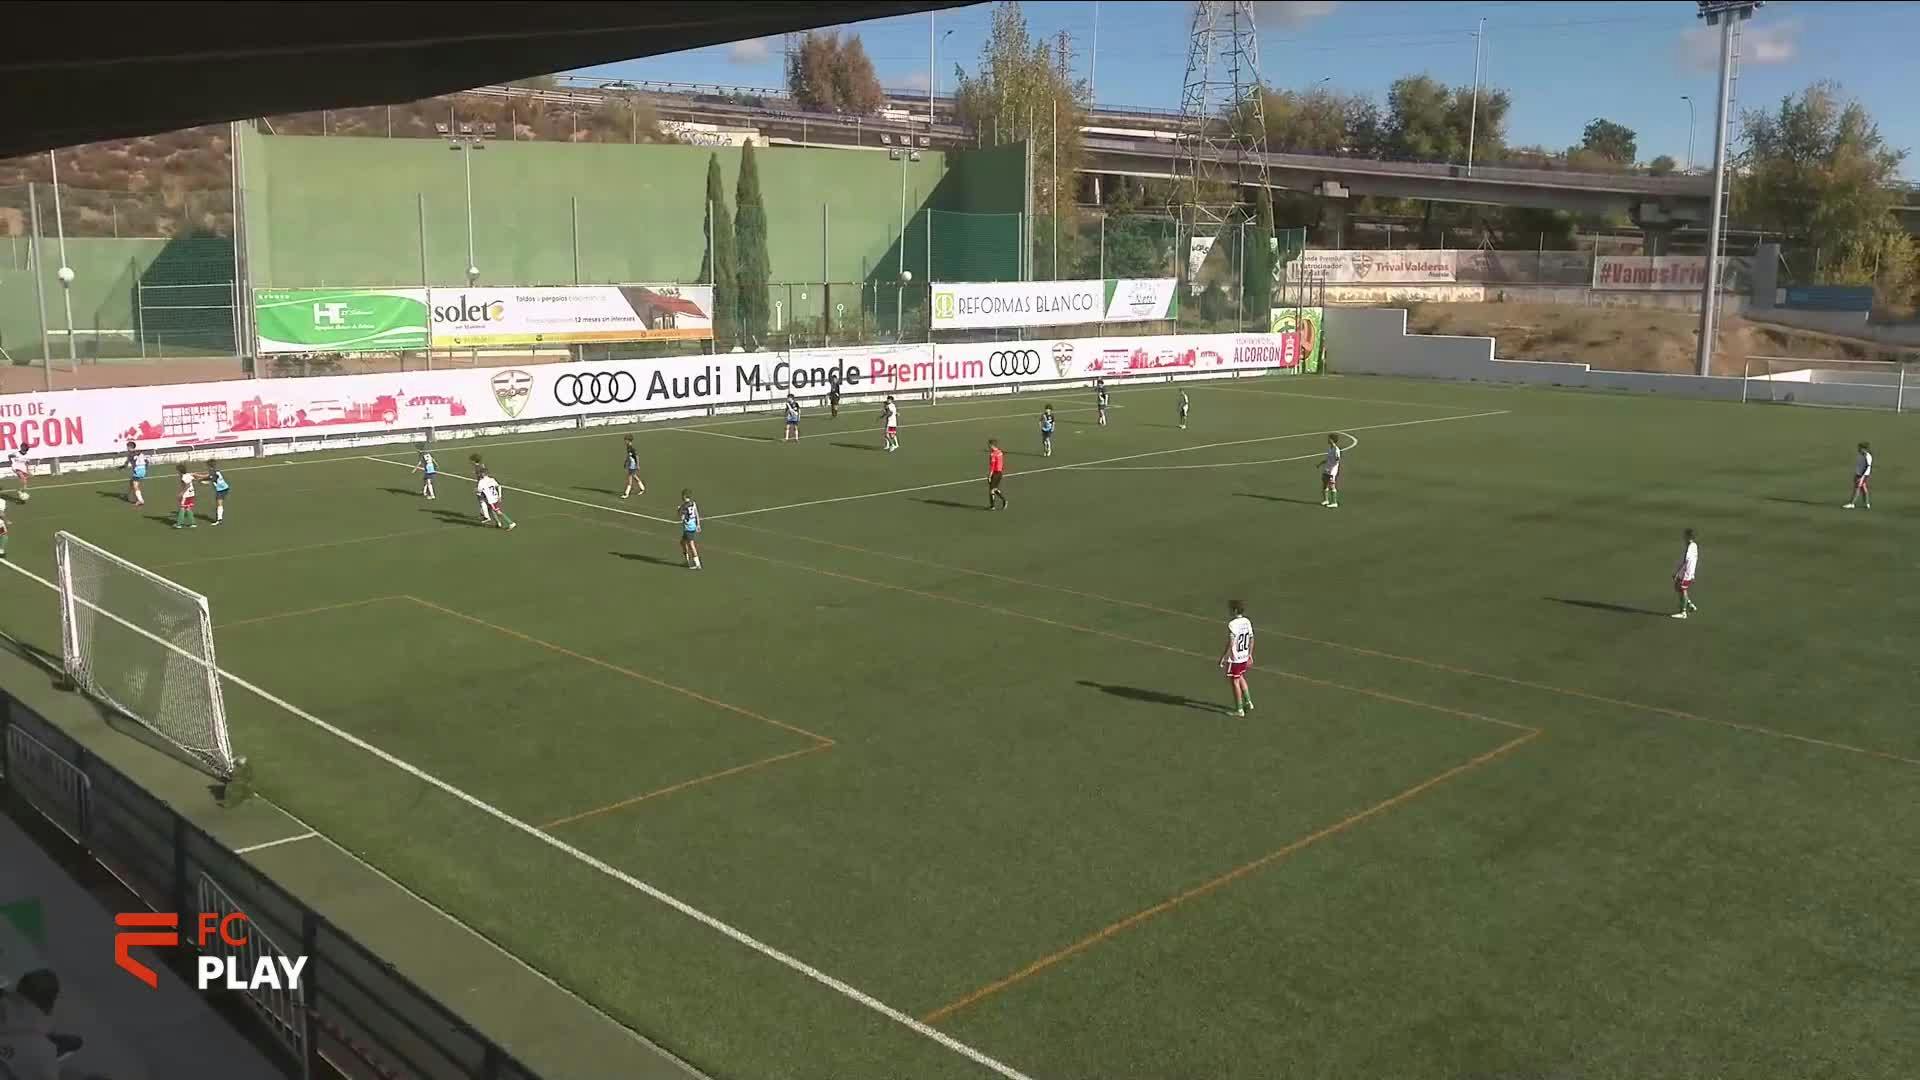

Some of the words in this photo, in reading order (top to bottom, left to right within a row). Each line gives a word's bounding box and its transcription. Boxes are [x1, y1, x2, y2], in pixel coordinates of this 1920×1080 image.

[958, 296, 1030, 315] REFORMAS
[1036, 293, 1093, 313] BLANCO
[646, 365, 721, 401] Audi
[735, 357, 861, 393] M.Conde
[870, 356, 984, 386] Premium
[28, 402, 46, 416] DE
[1237, 632, 1250, 653] 20
